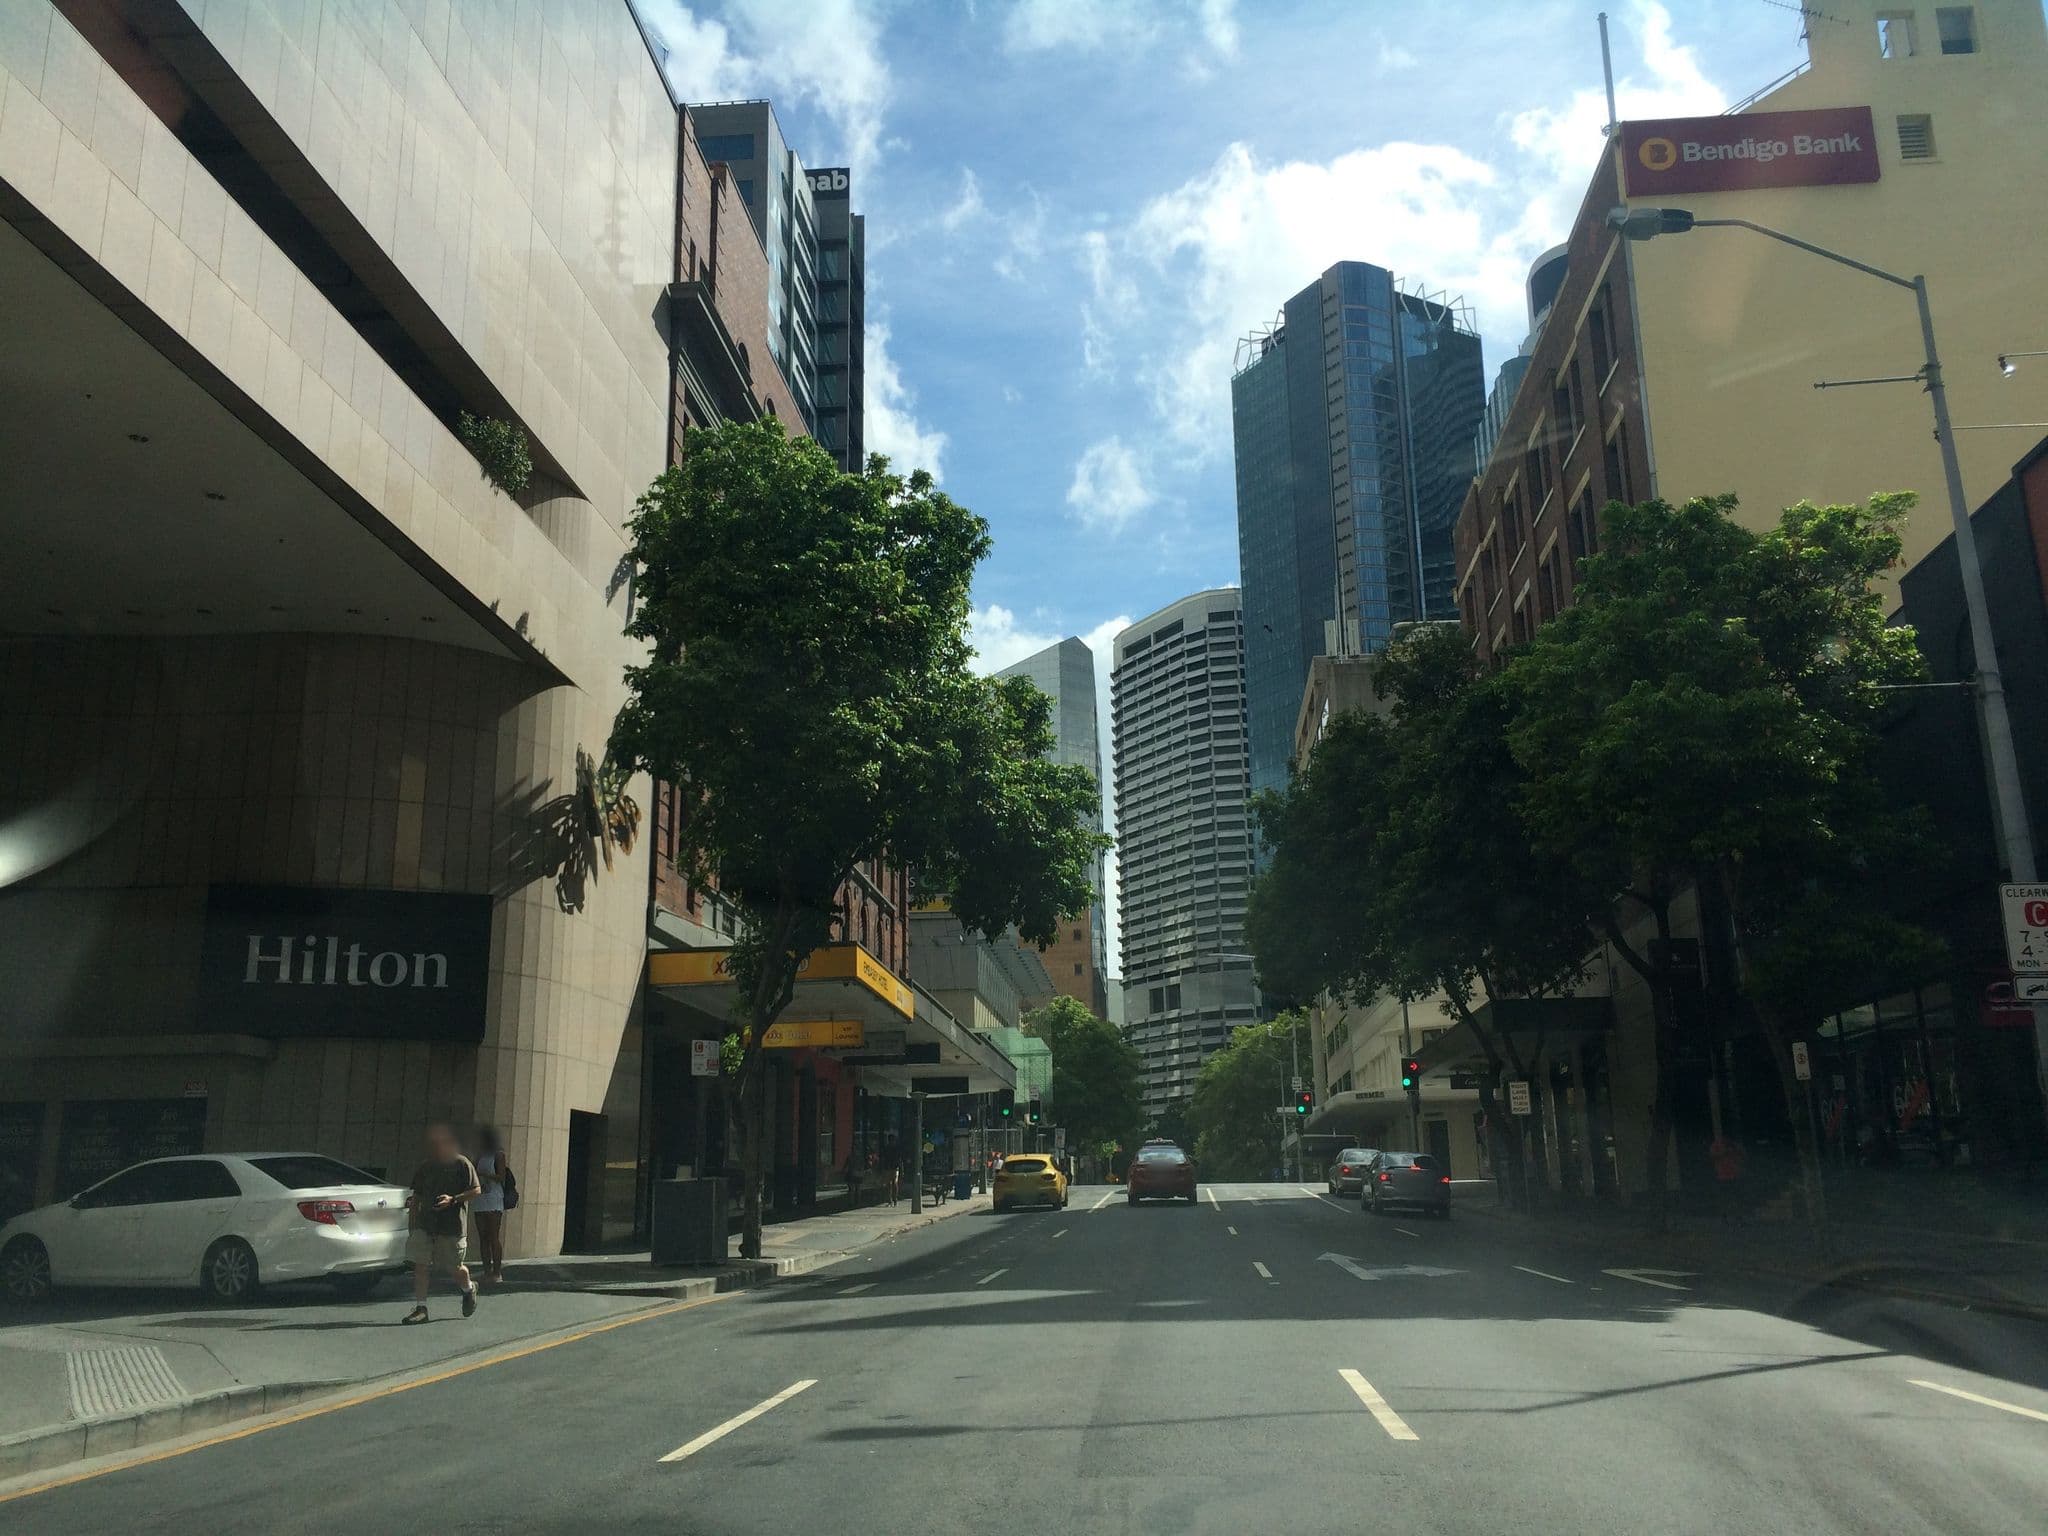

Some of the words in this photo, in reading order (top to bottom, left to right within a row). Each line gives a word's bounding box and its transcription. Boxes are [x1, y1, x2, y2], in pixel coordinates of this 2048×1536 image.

[1683, 138, 1788, 162] Bendigo
[1793, 133, 1863, 155] Bank
[243, 935, 449, 988] Hilton
